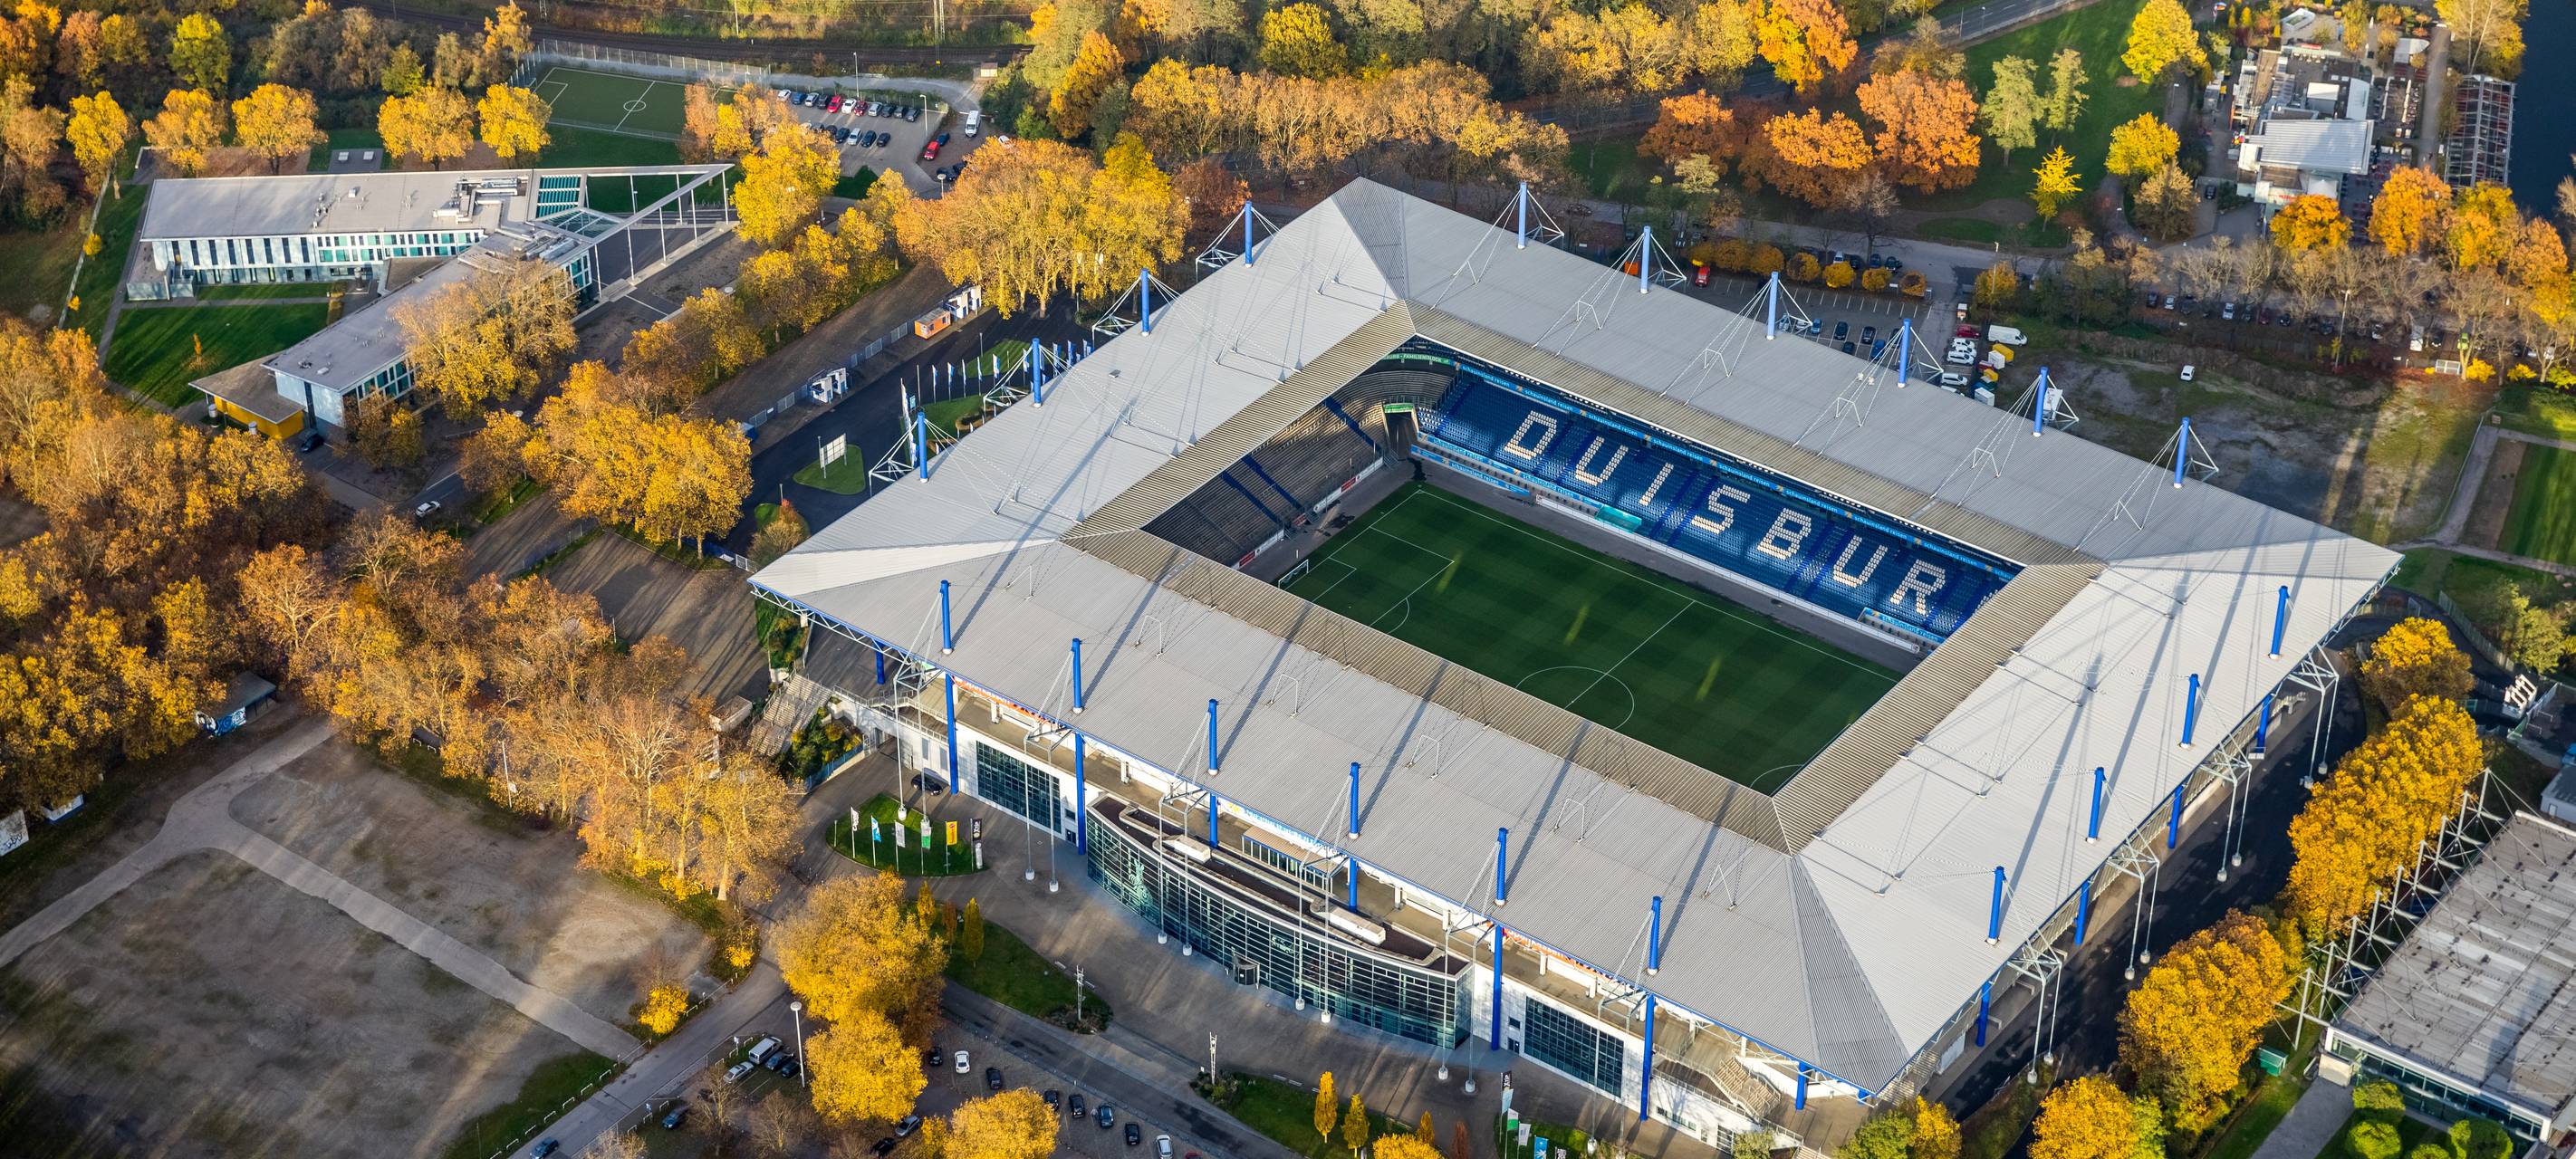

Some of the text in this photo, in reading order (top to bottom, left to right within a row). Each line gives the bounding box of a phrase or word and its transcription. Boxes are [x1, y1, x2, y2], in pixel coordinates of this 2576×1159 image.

[1461, 364, 1510, 388] schauinsland reisen
[1523, 388, 1573, 412] schauinsland reisen
[1588, 413, 1638, 436] schauinsland reisen
[1652, 437, 1704, 461] schauinsland reisen
[1718, 463, 1770, 486] schauinsland reisen
[1785, 488, 1838, 512] schauinsland reisen
[1504, 410, 1998, 616] DUISBUR
[1853, 514, 1907, 539] schauinsland reisen
[1923, 541, 1977, 565] schauinsland reisen
